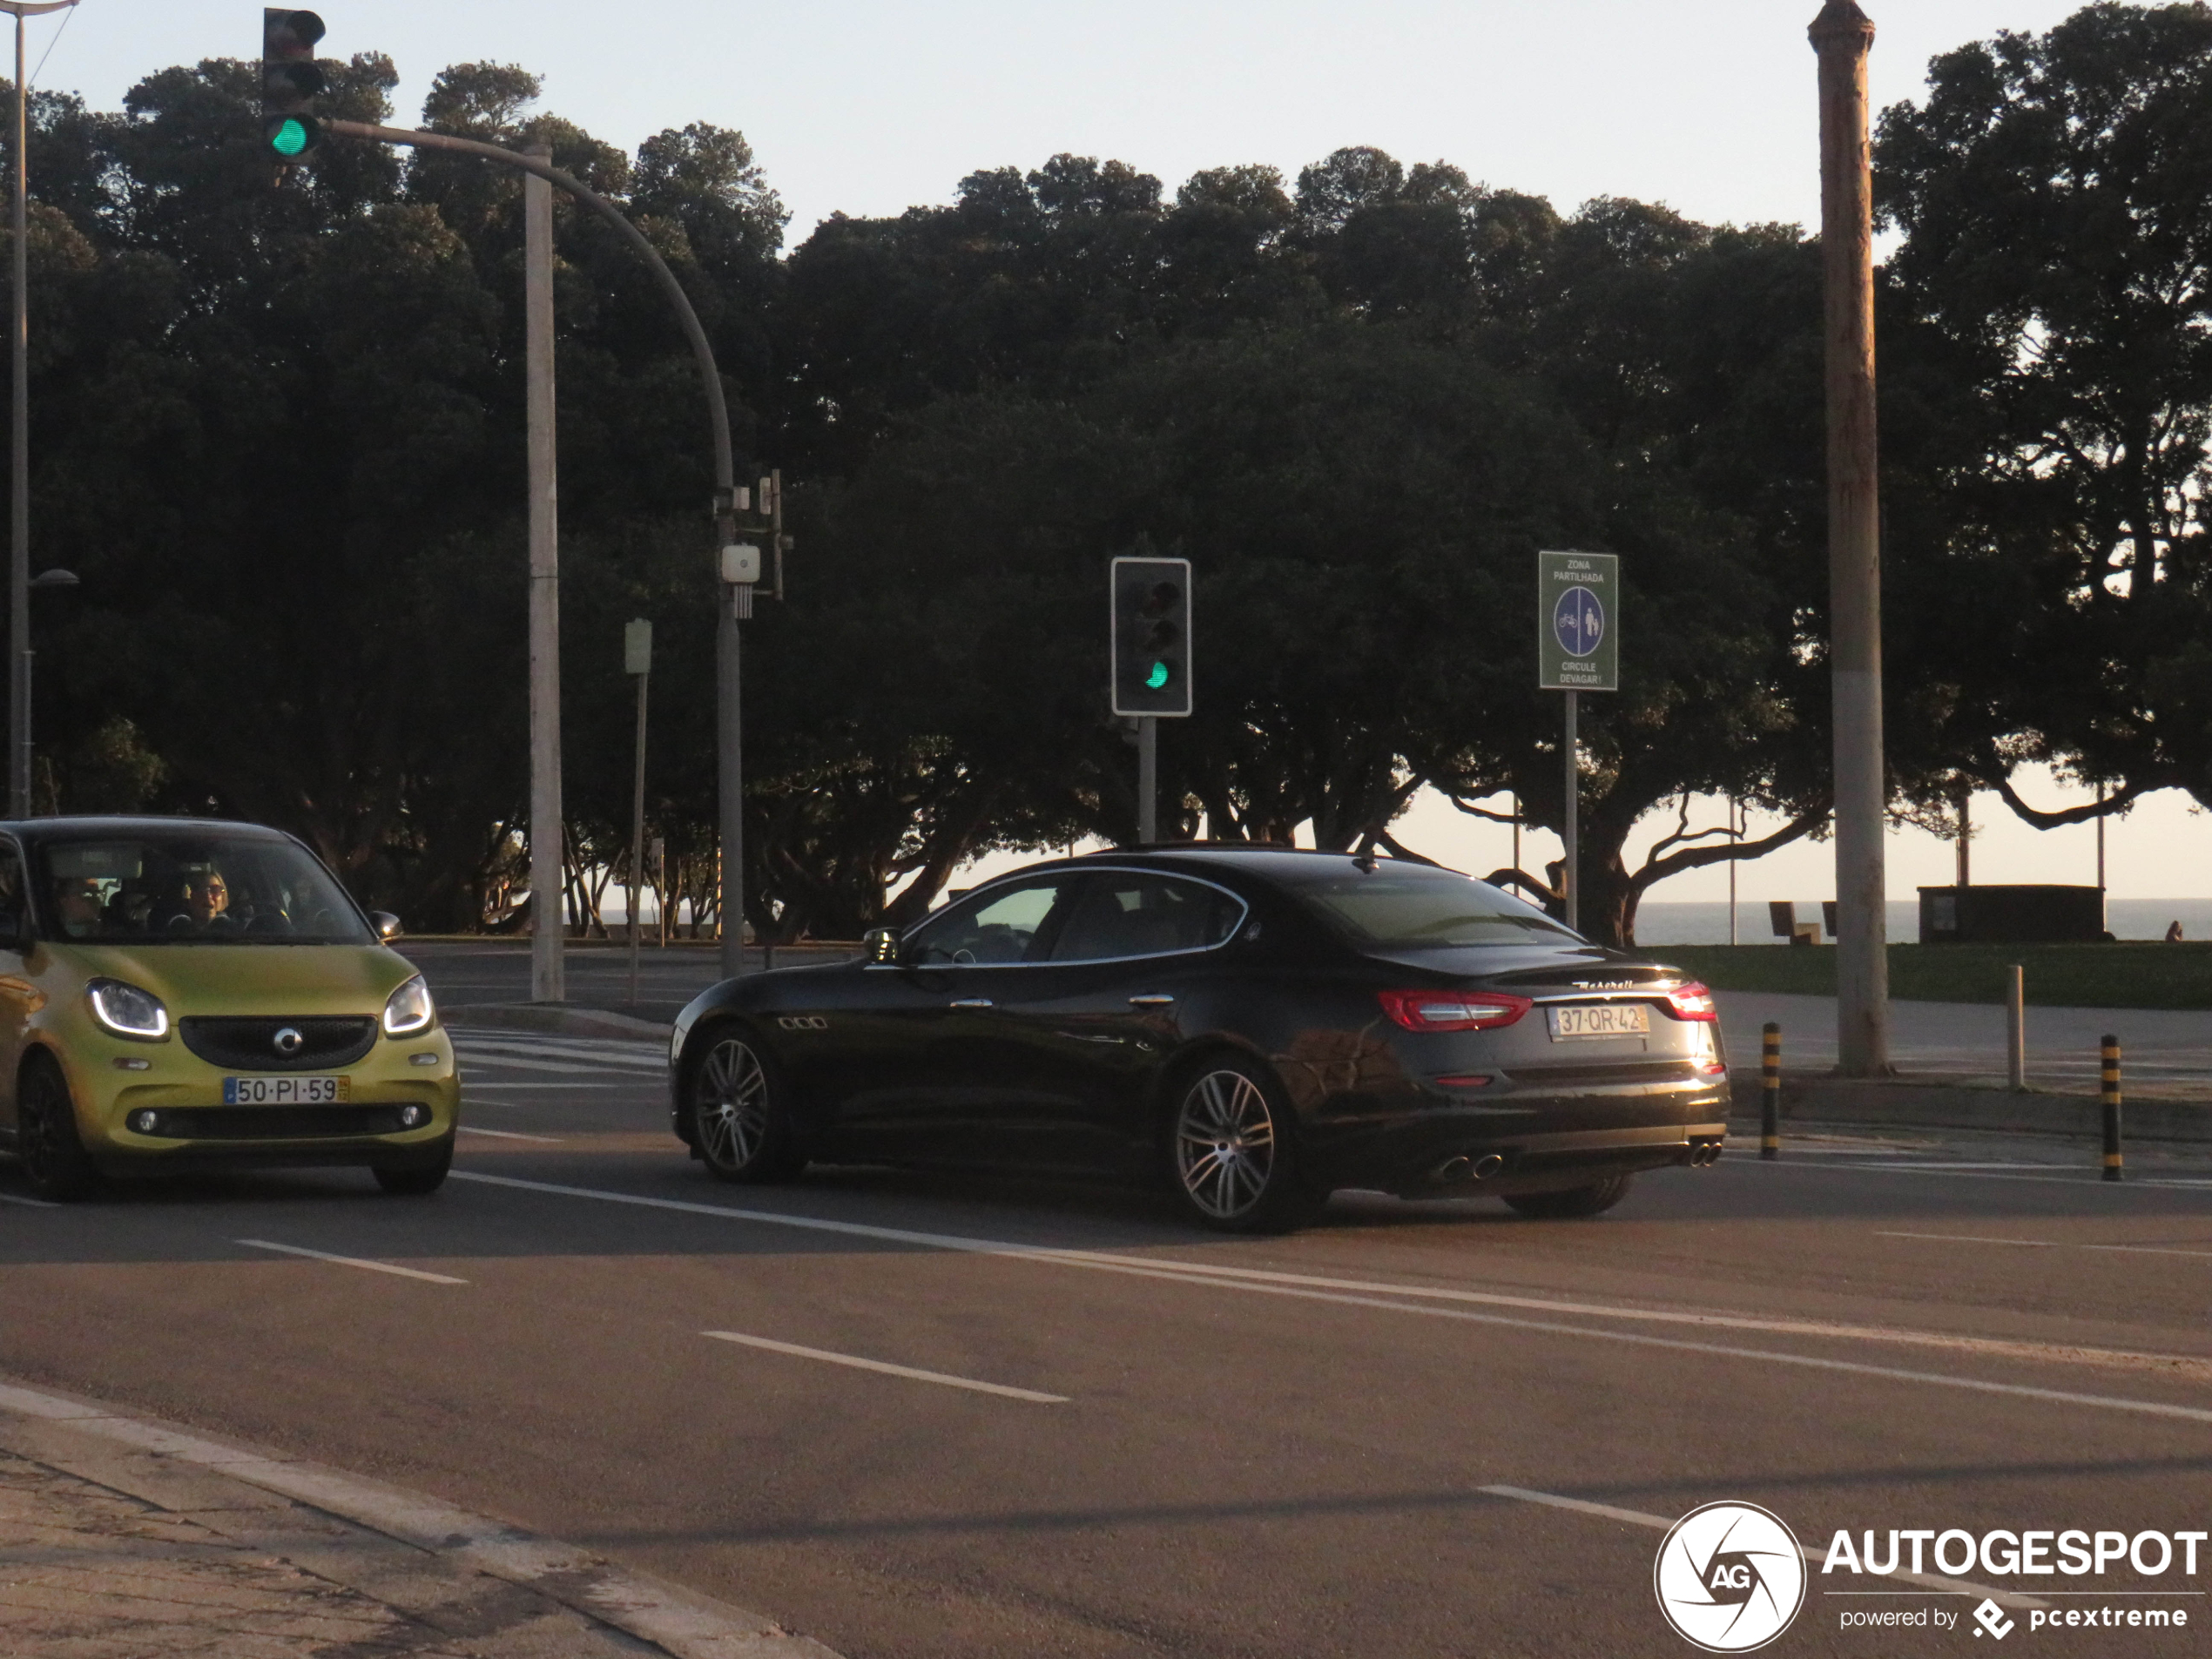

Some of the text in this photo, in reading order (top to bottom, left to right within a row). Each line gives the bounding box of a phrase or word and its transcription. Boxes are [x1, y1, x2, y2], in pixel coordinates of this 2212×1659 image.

[1568, 560, 1590, 570] ZONA
[1554, 571, 1604, 583] PARTILHADA
[1561, 662, 1596, 672] CIRCULE
